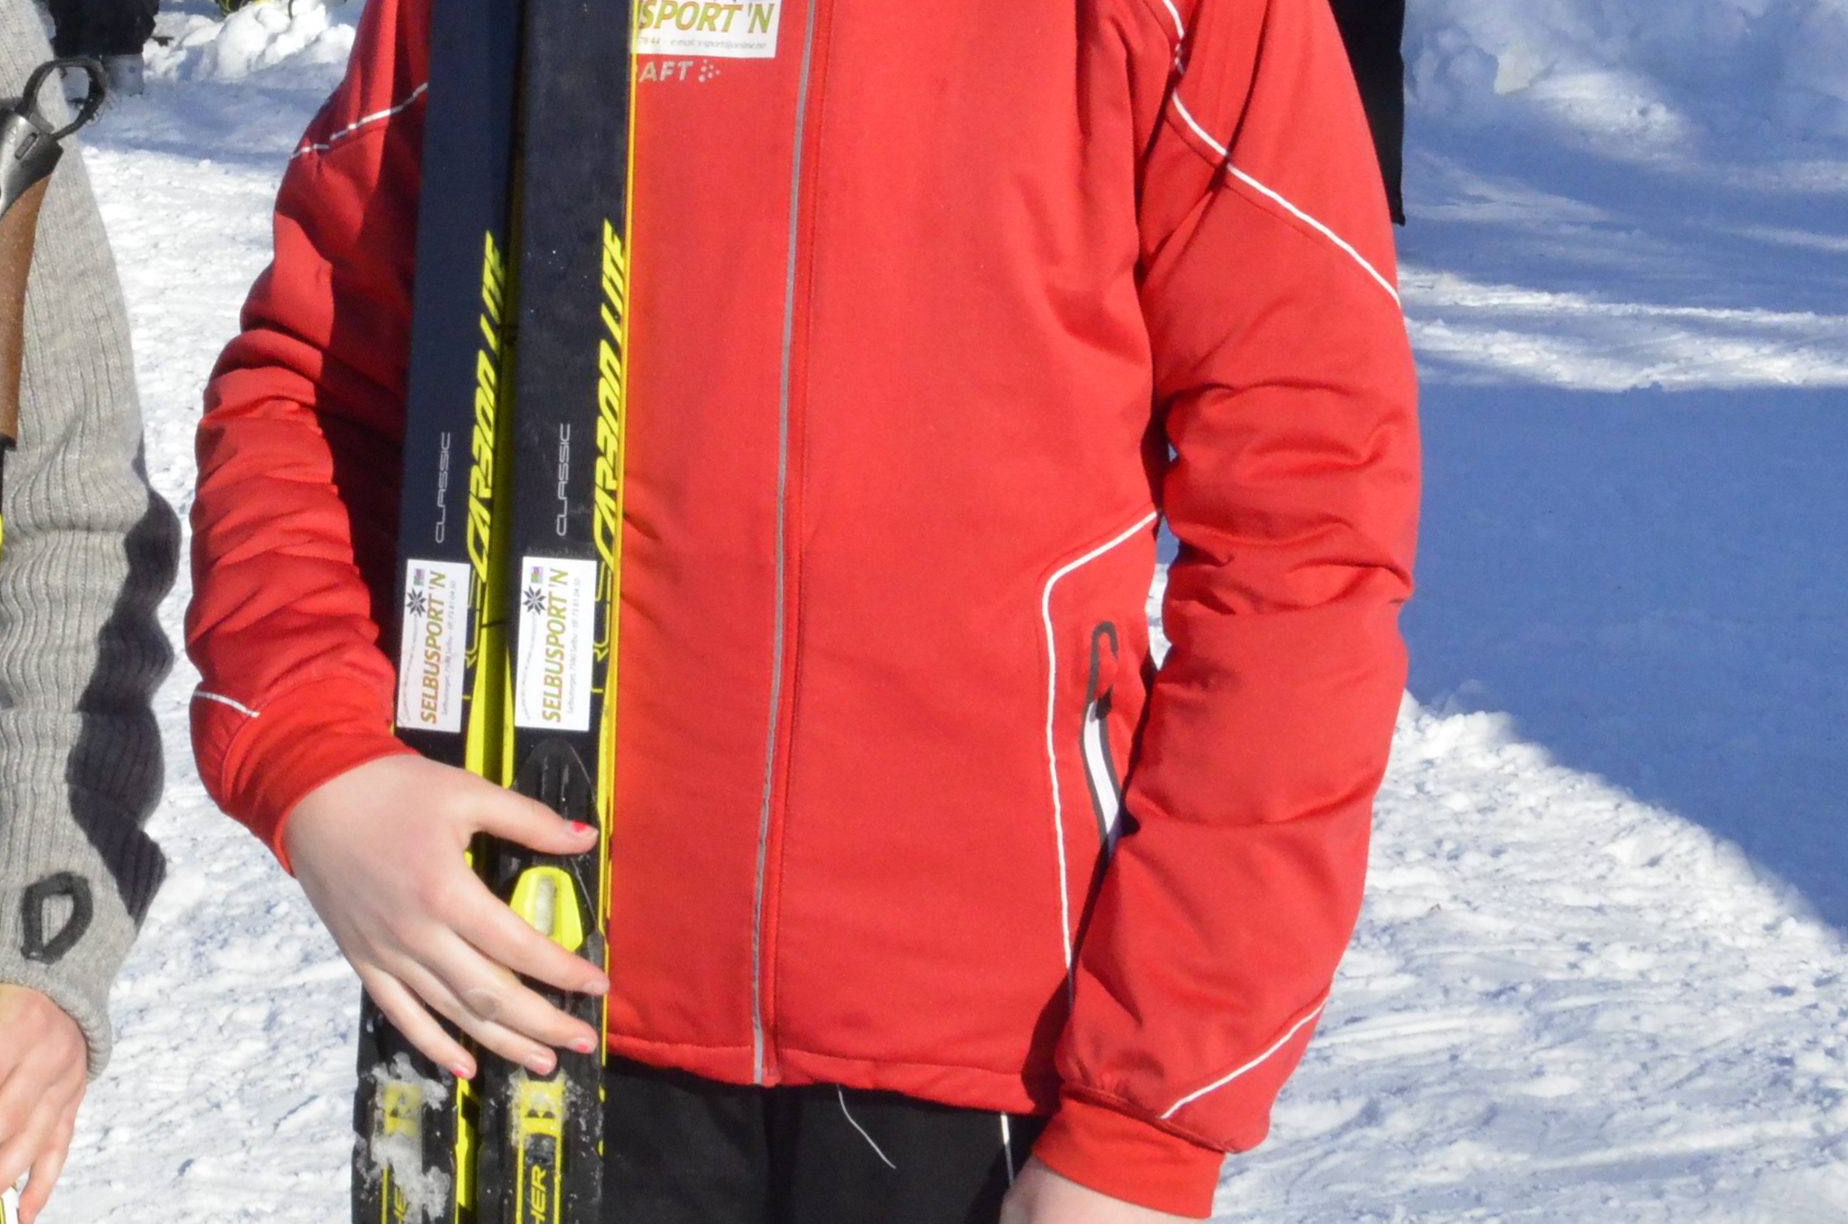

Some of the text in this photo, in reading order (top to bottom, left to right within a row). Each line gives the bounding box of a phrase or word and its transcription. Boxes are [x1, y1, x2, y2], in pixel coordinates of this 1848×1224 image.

[636, 60, 694, 83] AFT
[601, 219, 625, 340] LITE
[434, 432, 451, 544] CLASSIC
[468, 350, 494, 578] CARBON
[556, 423, 571, 537] CLASSIC
[595, 342, 619, 570] CARBON
[420, 593, 444, 724] SELBUSPORT
[542, 591, 567, 723] SELBUSPORT
